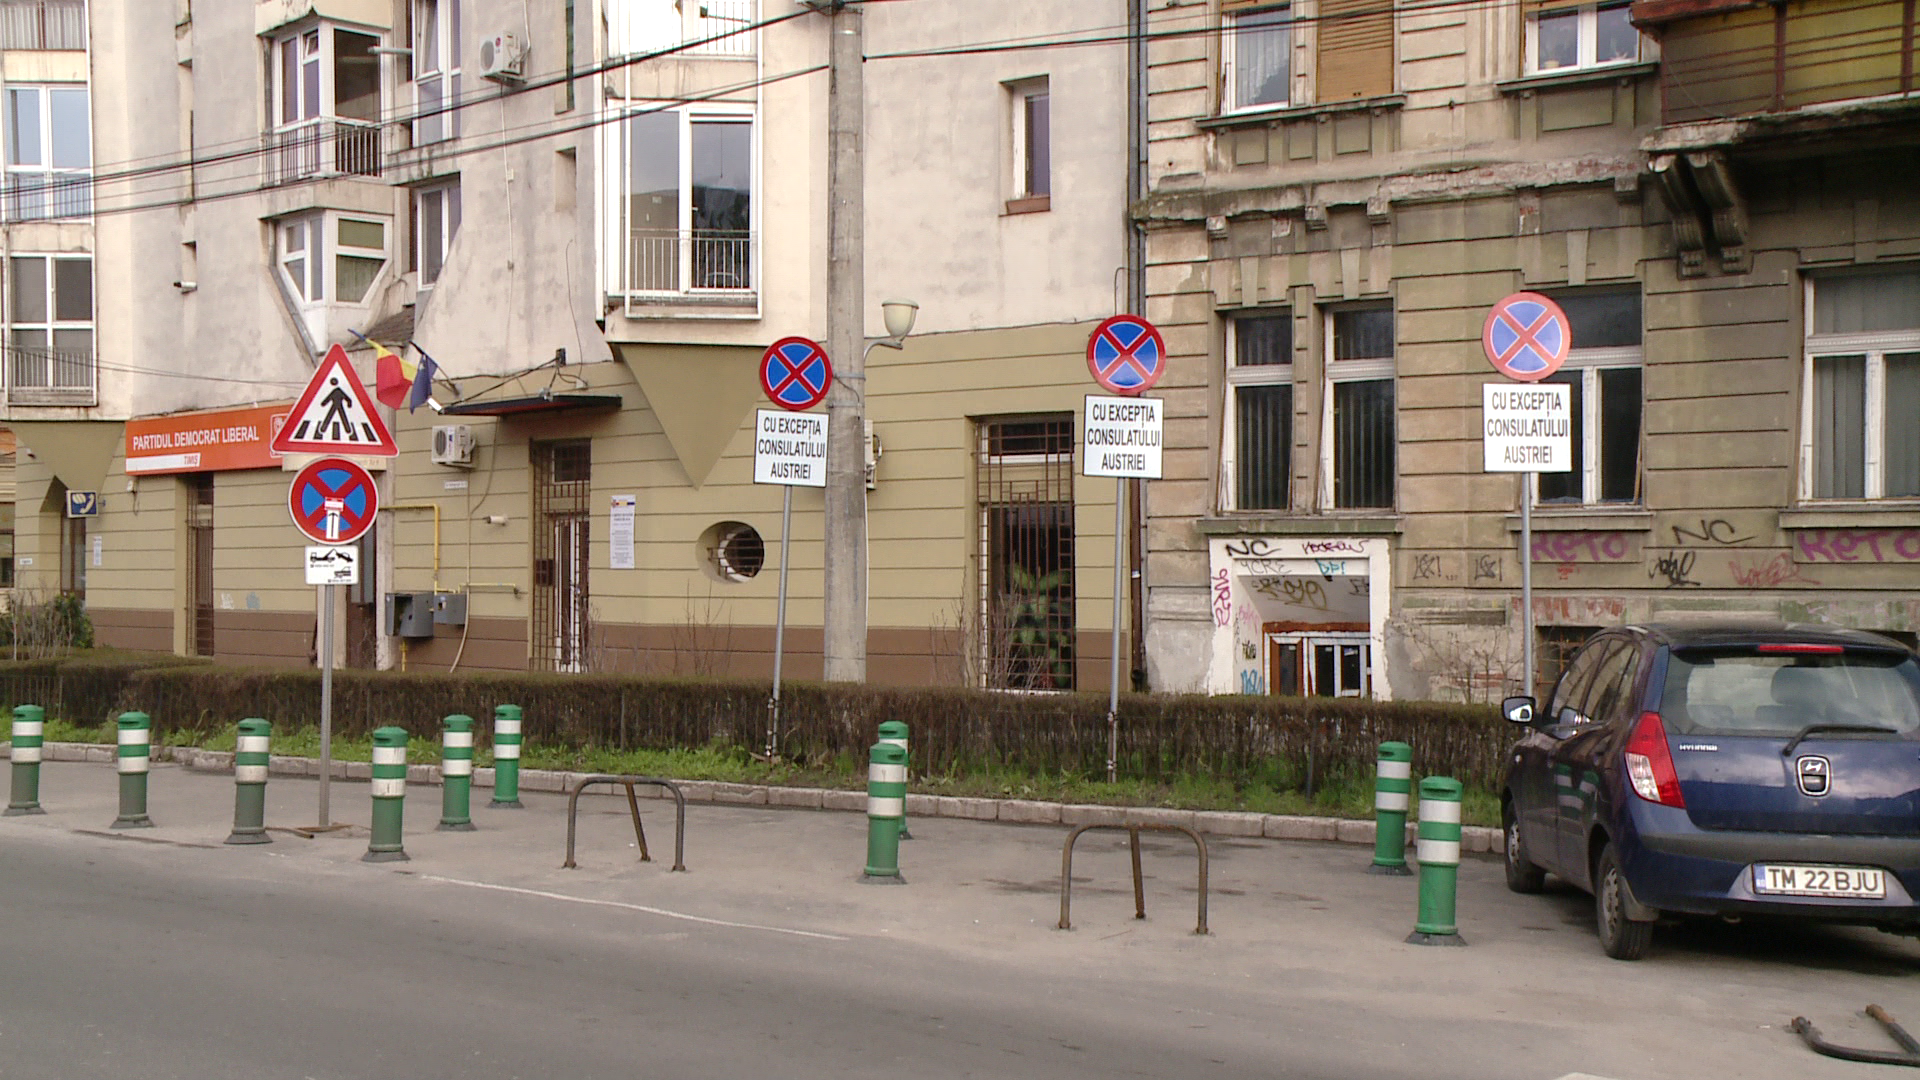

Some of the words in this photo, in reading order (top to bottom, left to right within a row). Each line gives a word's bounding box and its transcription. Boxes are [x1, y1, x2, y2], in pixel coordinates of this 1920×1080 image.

[1492, 392, 1507, 410] CU
[1510, 392, 1562, 417] EXCEPȚIA
[1092, 404, 1106, 421] CU
[1109, 404, 1155, 428] EXCEPȚIA
[763, 416, 777, 432] CU
[779, 418, 822, 440] EXCEPȚIA
[1087, 428, 1160, 447] CONSULATULUI
[1487, 419, 1568, 437] CONSULATULUI
[133, 434, 173, 451] PARTIDUL
[174, 429, 221, 447] DEMOCRAT
[222, 425, 260, 443] LIBERAL
[758, 439, 826, 458] CONSULATULUI
[1504, 446, 1552, 464] AUSTRIEI
[770, 462, 811, 479] AUSTRIEI
[1101, 453, 1146, 471] AUSTRIEI
[1671, 519, 1756, 545] NC
[1225, 540, 1282, 556] NC
[1768, 868, 1796, 889] TM
[1804, 870, 1831, 890] 22
[1835, 871, 1879, 892] BJU
